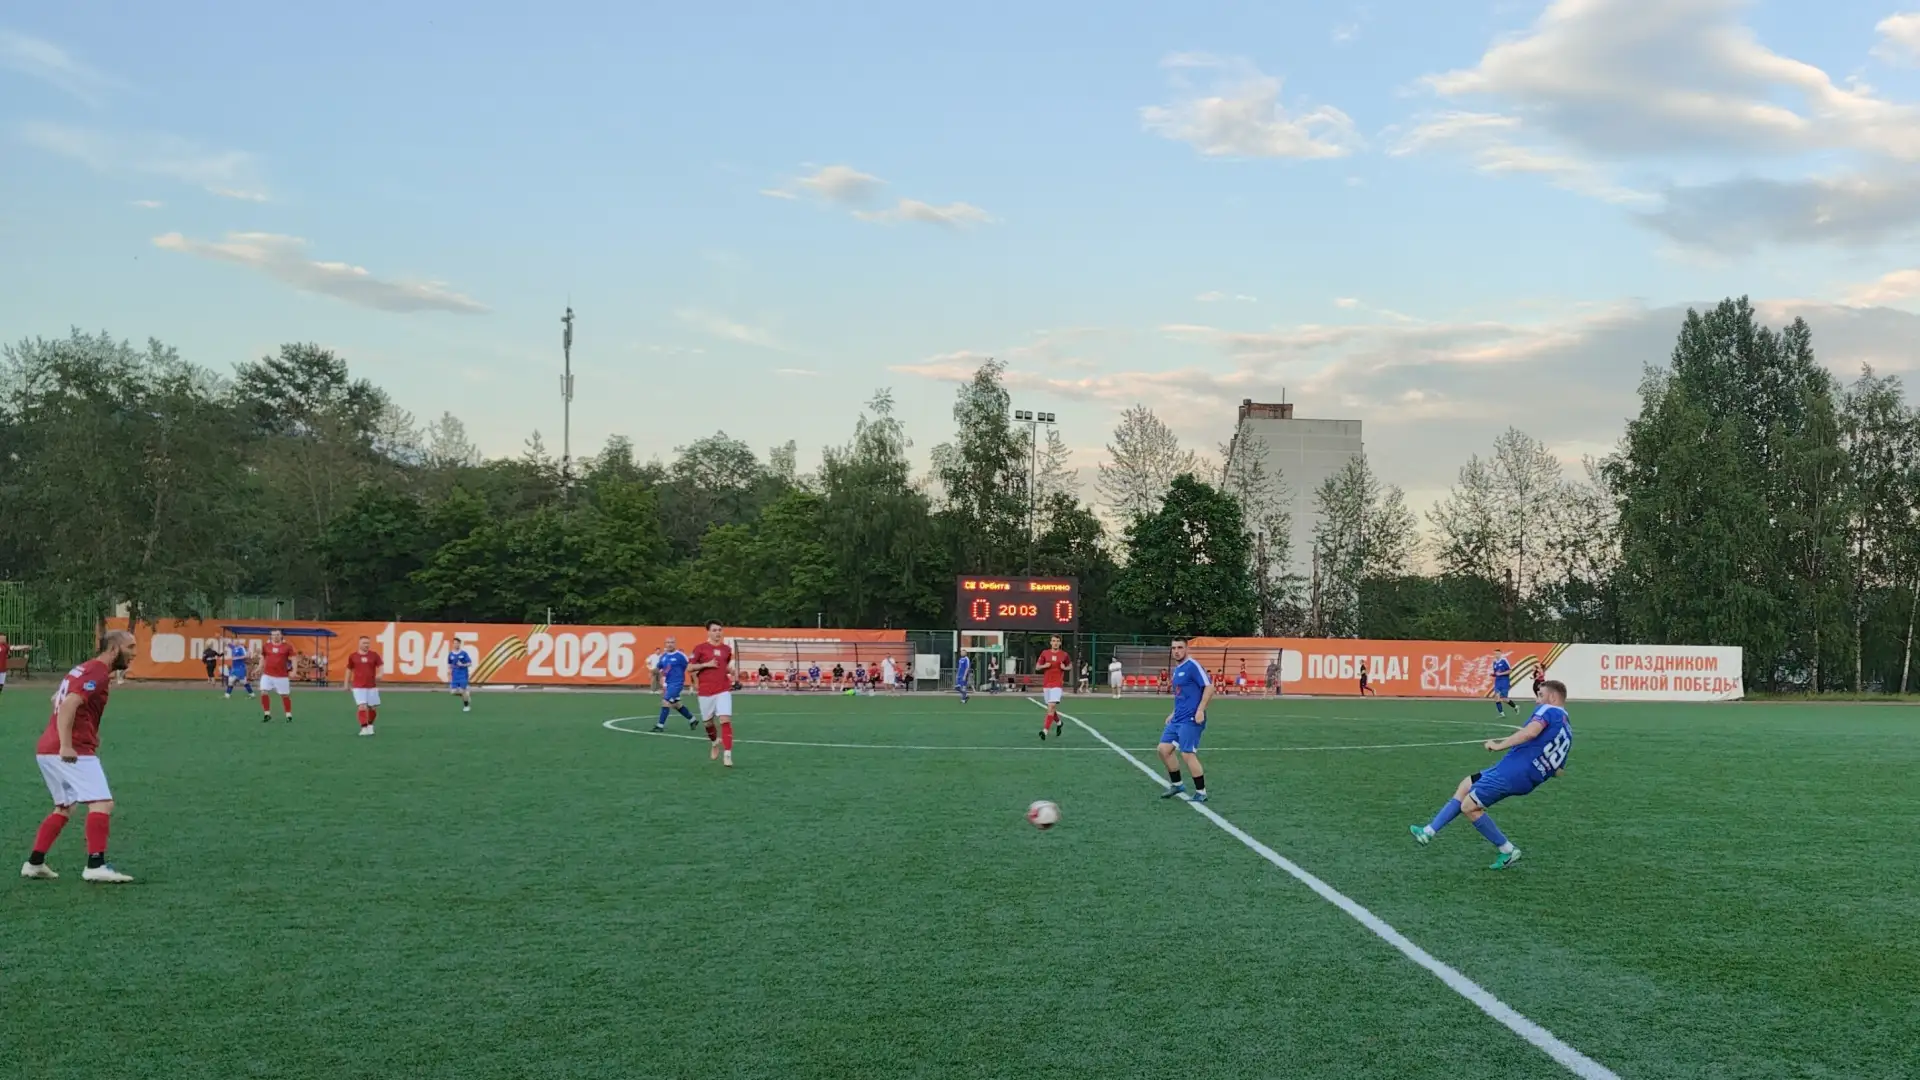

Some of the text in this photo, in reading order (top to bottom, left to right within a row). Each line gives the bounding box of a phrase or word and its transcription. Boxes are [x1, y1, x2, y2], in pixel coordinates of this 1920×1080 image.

[979, 581, 1010, 591] Орбита
[972, 598, 990, 621] 0
[1056, 600, 1073, 622] 0
[526, 632, 636, 678] 2026
[1600, 654, 1718, 673] С ПРАЗДНИКОМ
[1308, 654, 1409, 684] ПОБЕДА!
[1600, 674, 1669, 691] ВЕЛИКОЙ
[1543, 726, 1570, 770] 59
